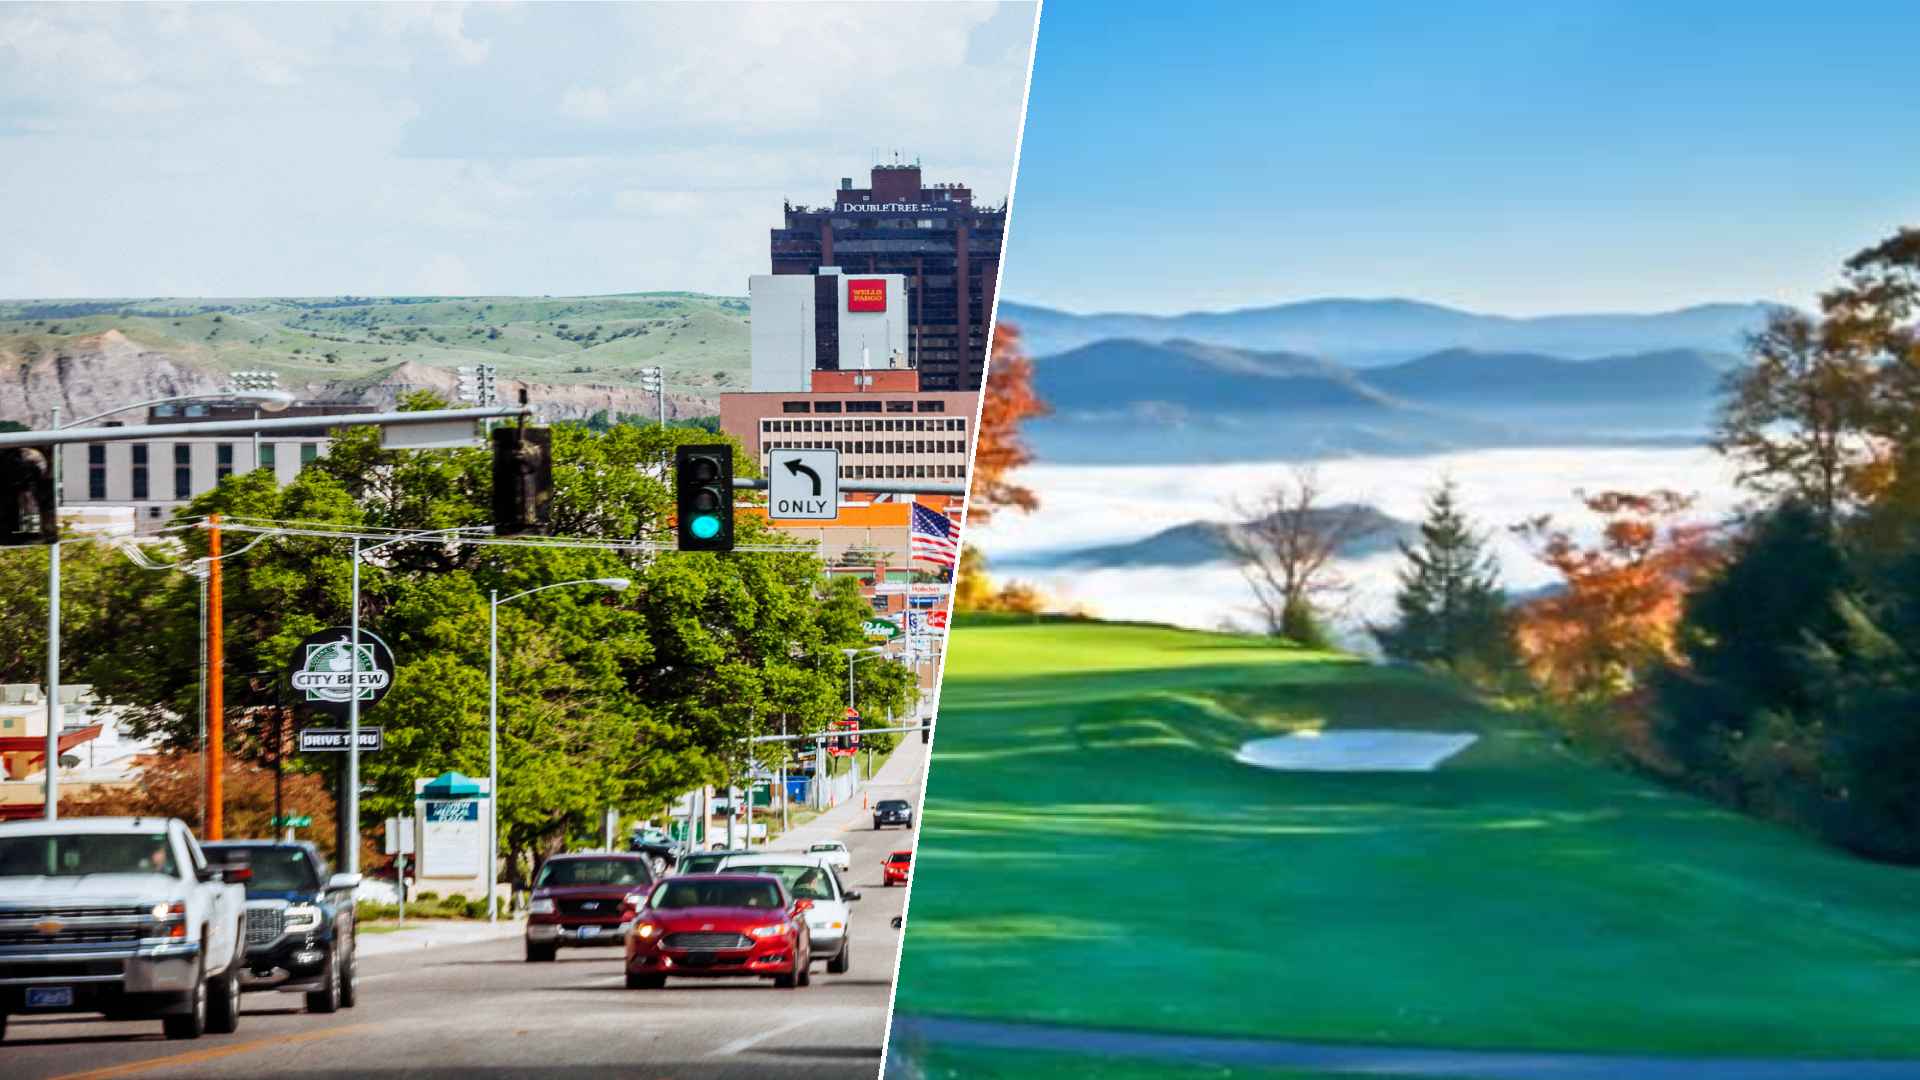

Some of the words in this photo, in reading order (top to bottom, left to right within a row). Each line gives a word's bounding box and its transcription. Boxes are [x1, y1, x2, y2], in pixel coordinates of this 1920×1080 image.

[778, 499, 828, 514] ONLY
[297, 674, 332, 685] CITY
[303, 735, 342, 747] DRIVE
